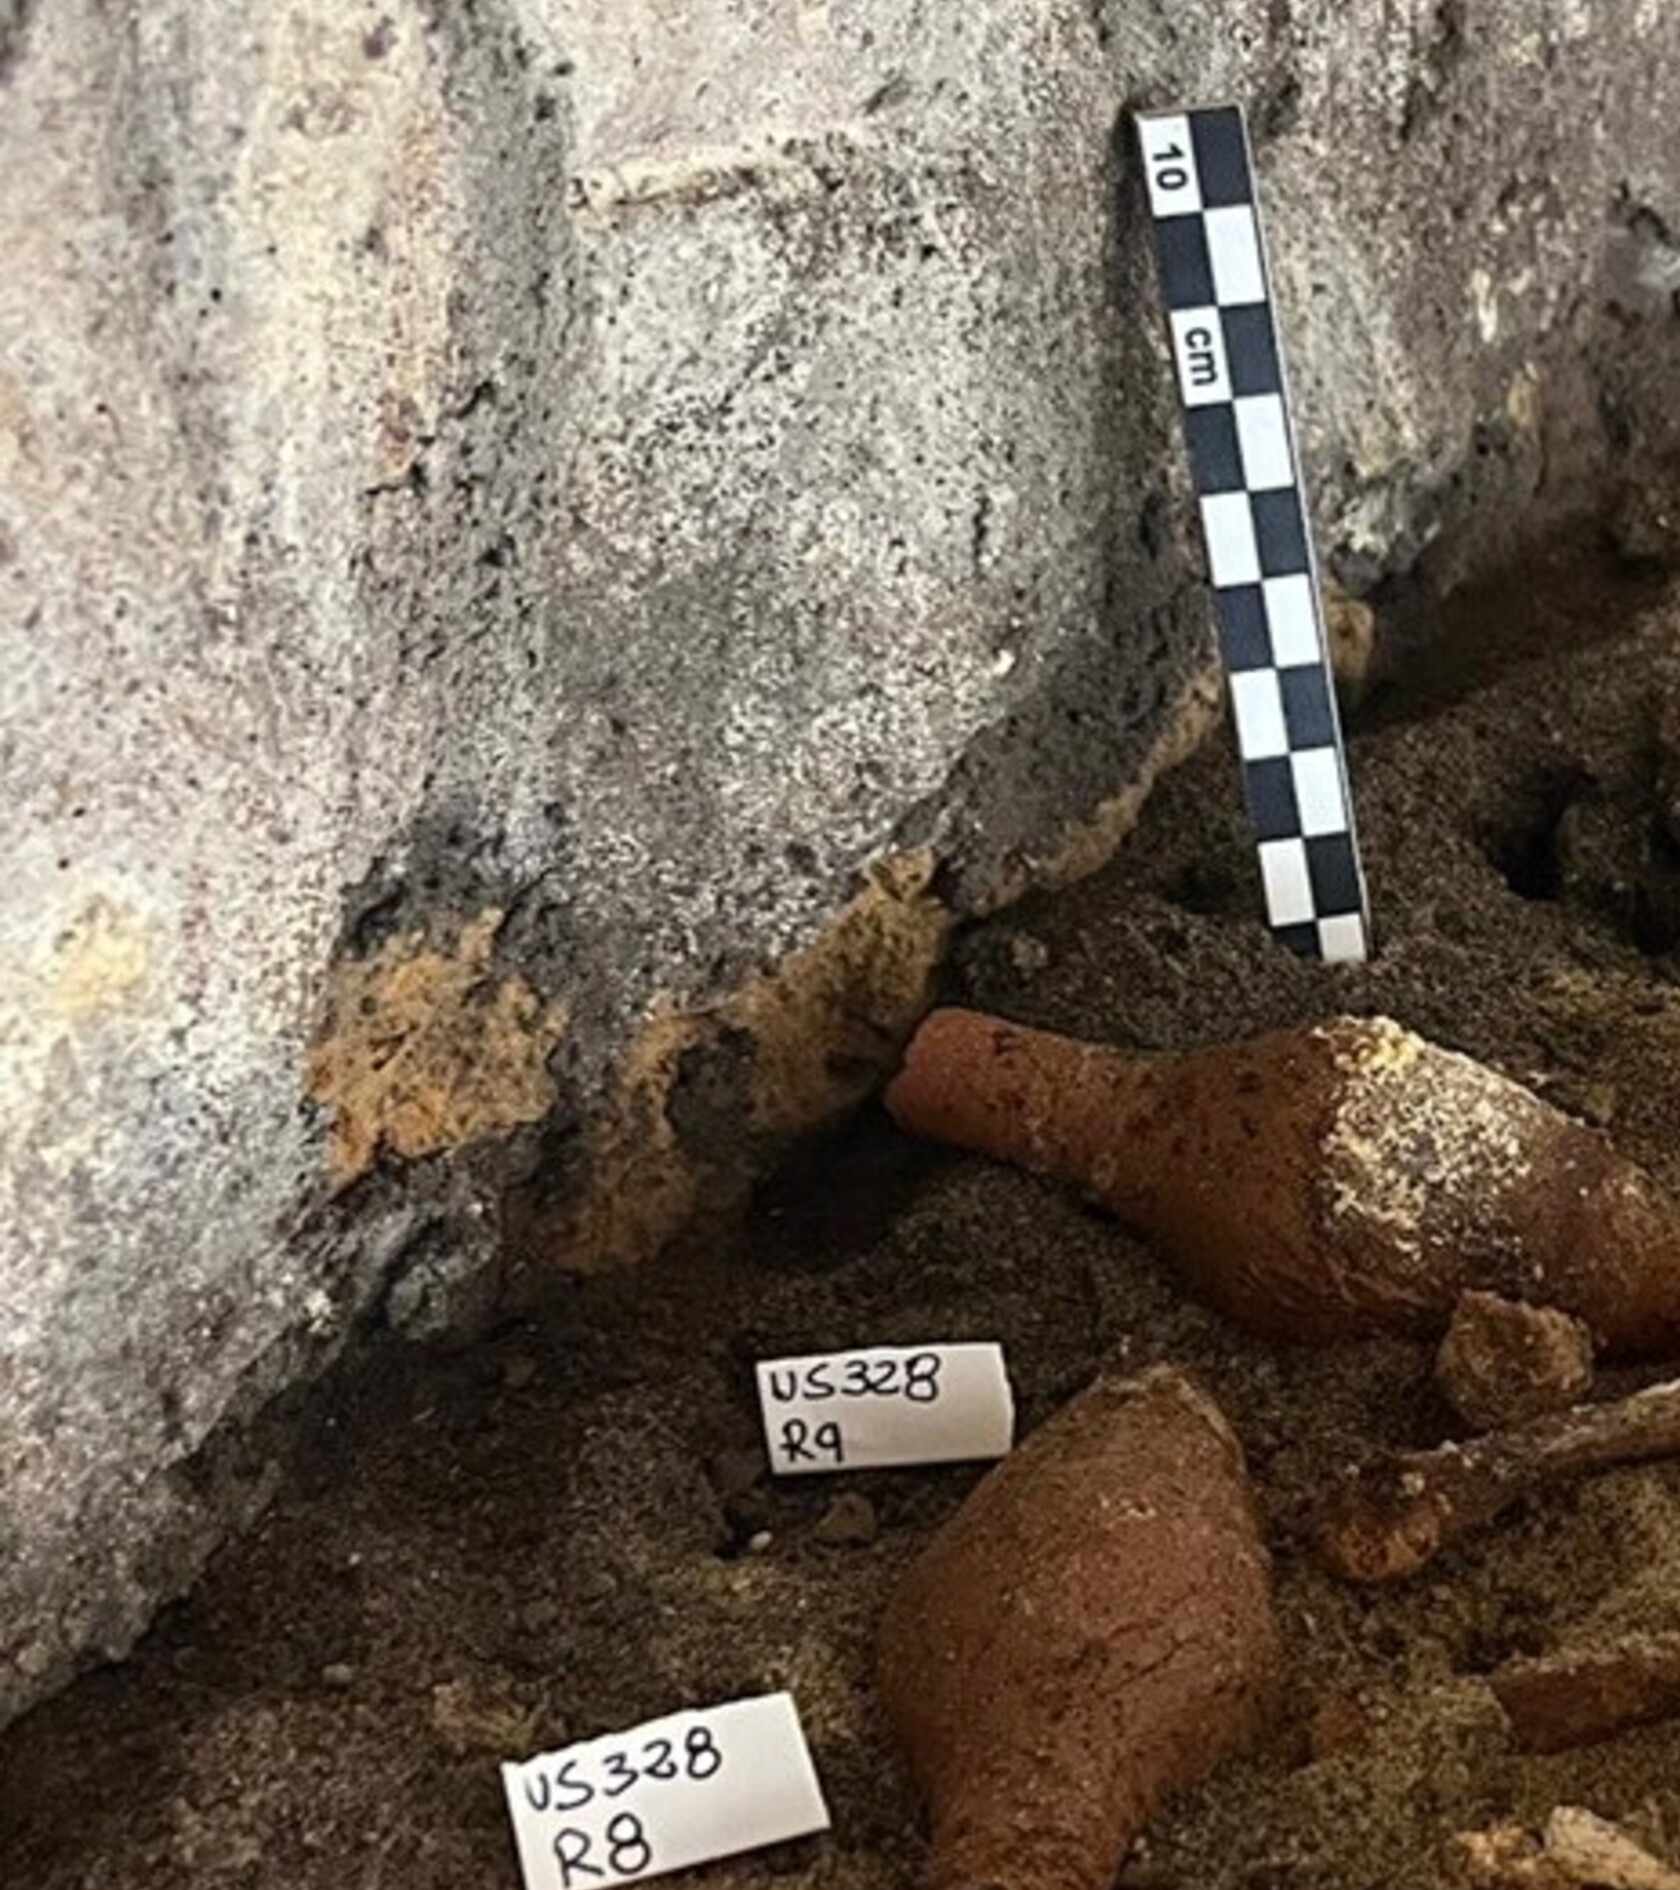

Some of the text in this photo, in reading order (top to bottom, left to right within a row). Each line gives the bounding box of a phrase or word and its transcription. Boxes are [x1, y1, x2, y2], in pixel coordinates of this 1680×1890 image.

[1152, 142, 1188, 190] 10
[1184, 327, 1218, 386] cm
[779, 1418, 844, 1462] R9
[554, 1812, 652, 1888] R8
